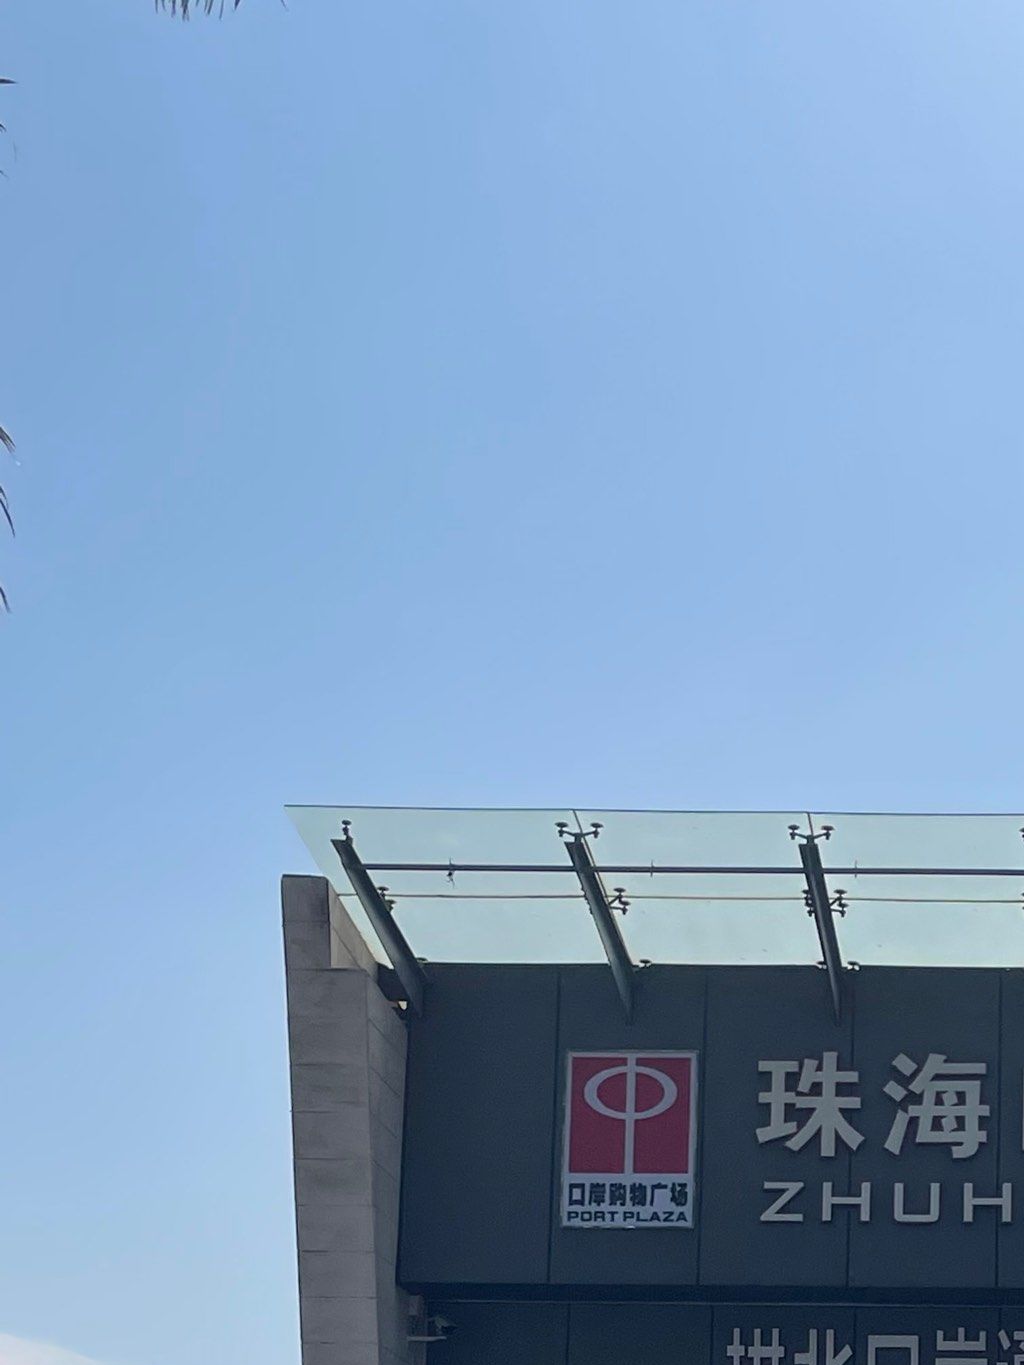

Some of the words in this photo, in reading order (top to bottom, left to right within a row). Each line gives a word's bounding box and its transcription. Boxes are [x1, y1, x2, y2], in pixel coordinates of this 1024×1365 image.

[567, 1182, 689, 1208] 口岸购物广场
[566, 1210, 622, 1223] PORT
[623, 1210, 689, 1223] PLAZA
